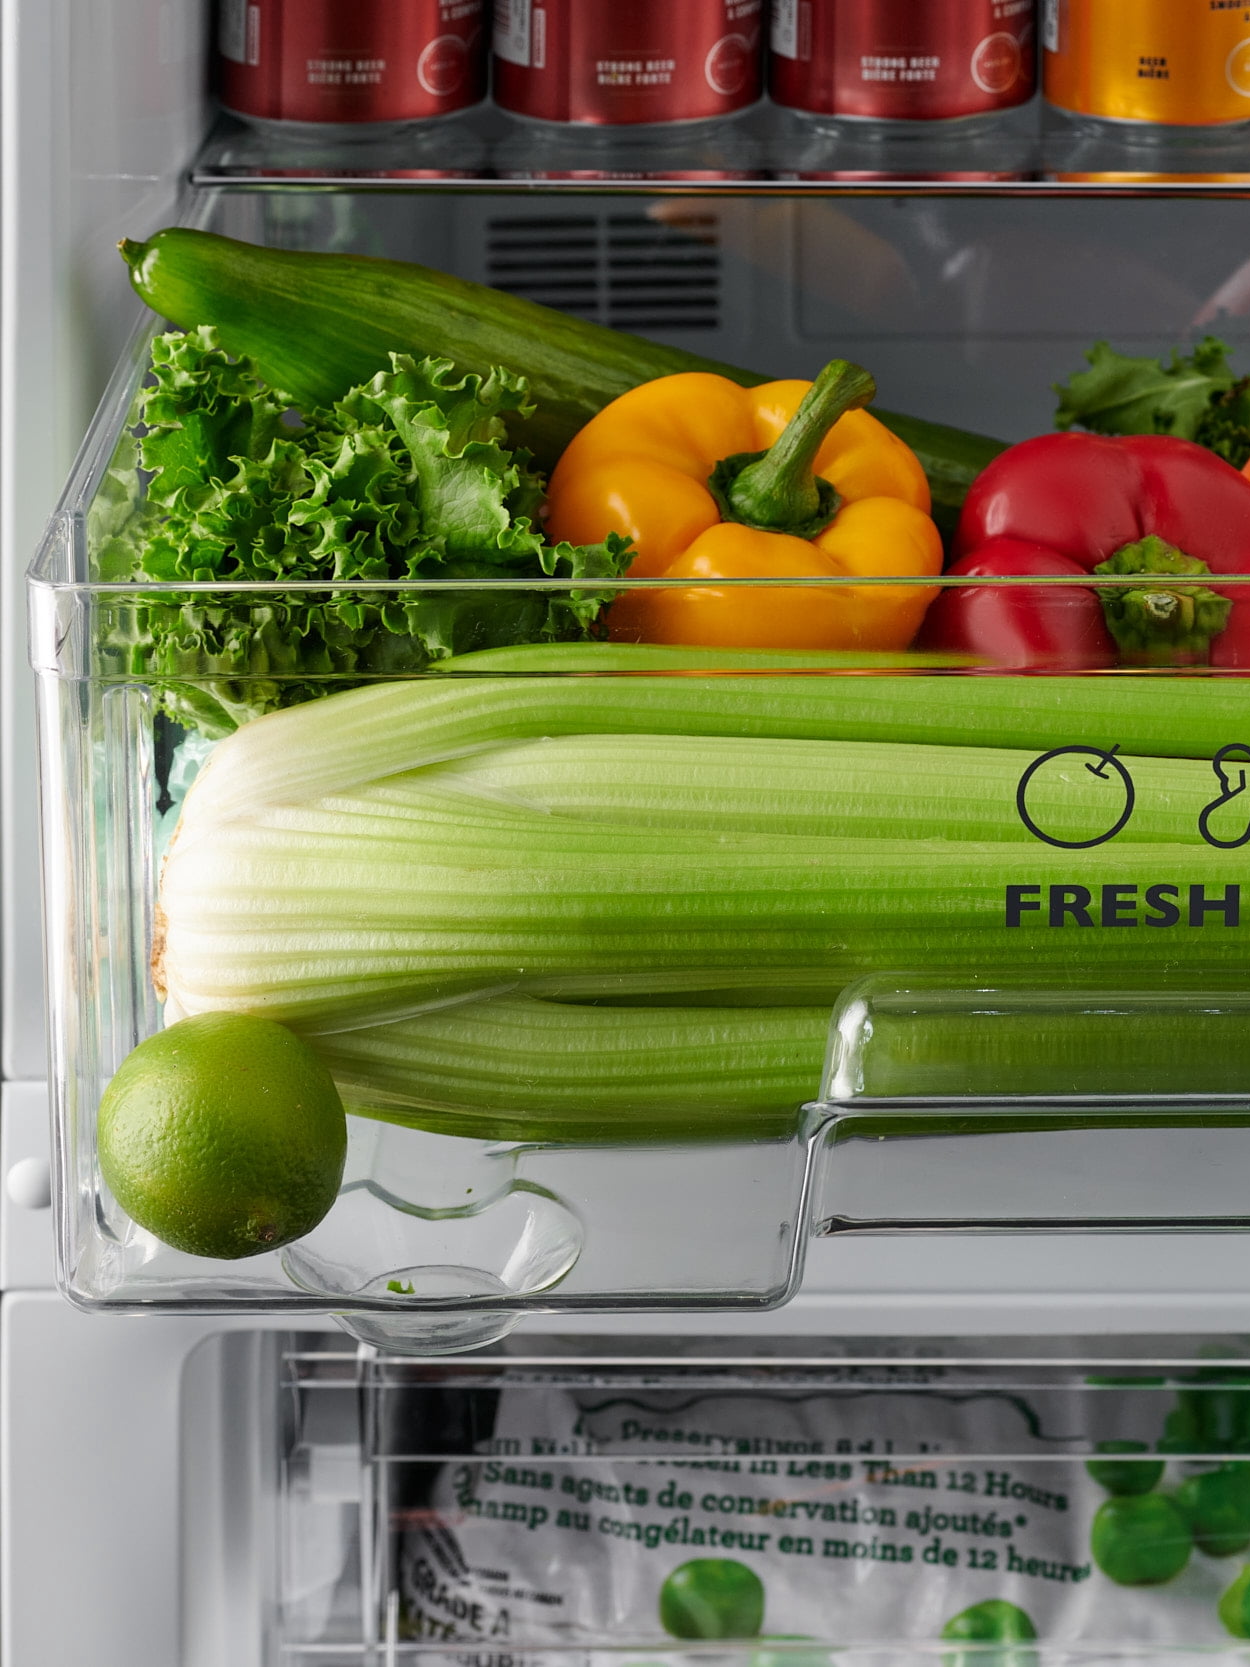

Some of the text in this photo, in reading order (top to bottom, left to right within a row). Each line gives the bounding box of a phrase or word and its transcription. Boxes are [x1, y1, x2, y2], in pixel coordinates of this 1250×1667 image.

[910, 56, 940, 68] BEER
[1005, 884, 1240, 928] FRESH
[484, 1461, 553, 1490] Sans
[561, 1476, 649, 1504] agents
[656, 1480, 693, 1510] de
[701, 1493, 897, 1527] conservation
[786, 1461, 852, 1480] Less
[861, 1461, 937, 1489] Than
[947, 1471, 976, 1493] 12
[984, 1471, 1070, 1513] Hours
[556, 1508, 592, 1532] au
[598, 1516, 771, 1551] congélateur
[778, 1533, 814, 1556] en
[823, 1537, 913, 1564] moins
[922, 1537, 958, 1568] de
[966, 1548, 997, 1571] 12
